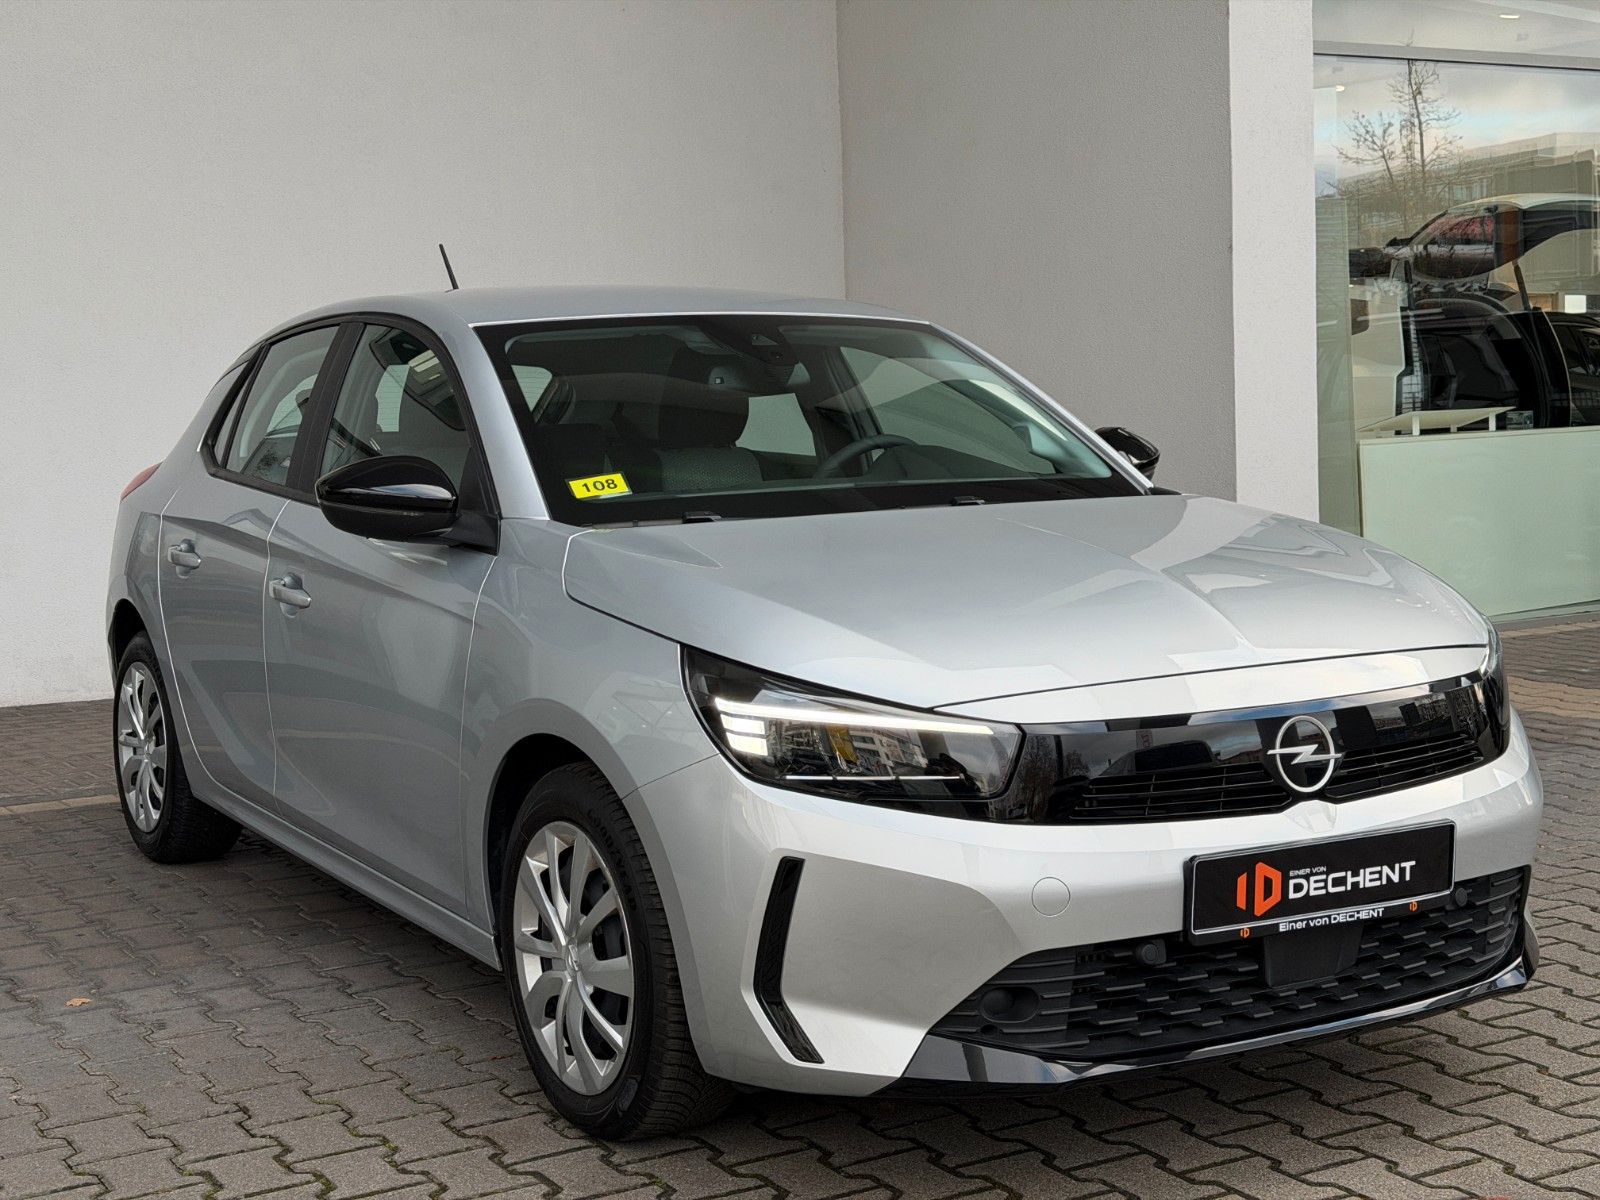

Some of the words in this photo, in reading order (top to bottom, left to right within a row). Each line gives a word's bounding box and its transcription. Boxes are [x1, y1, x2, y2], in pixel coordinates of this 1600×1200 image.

[582, 479, 618, 493] 108
[1288, 860, 1416, 900] DECHENT
[1289, 868, 1311, 877] EINER
[1279, 920, 1307, 932] Einer
[1309, 917, 1329, 927] von
[1330, 908, 1384, 924] DECHENT
